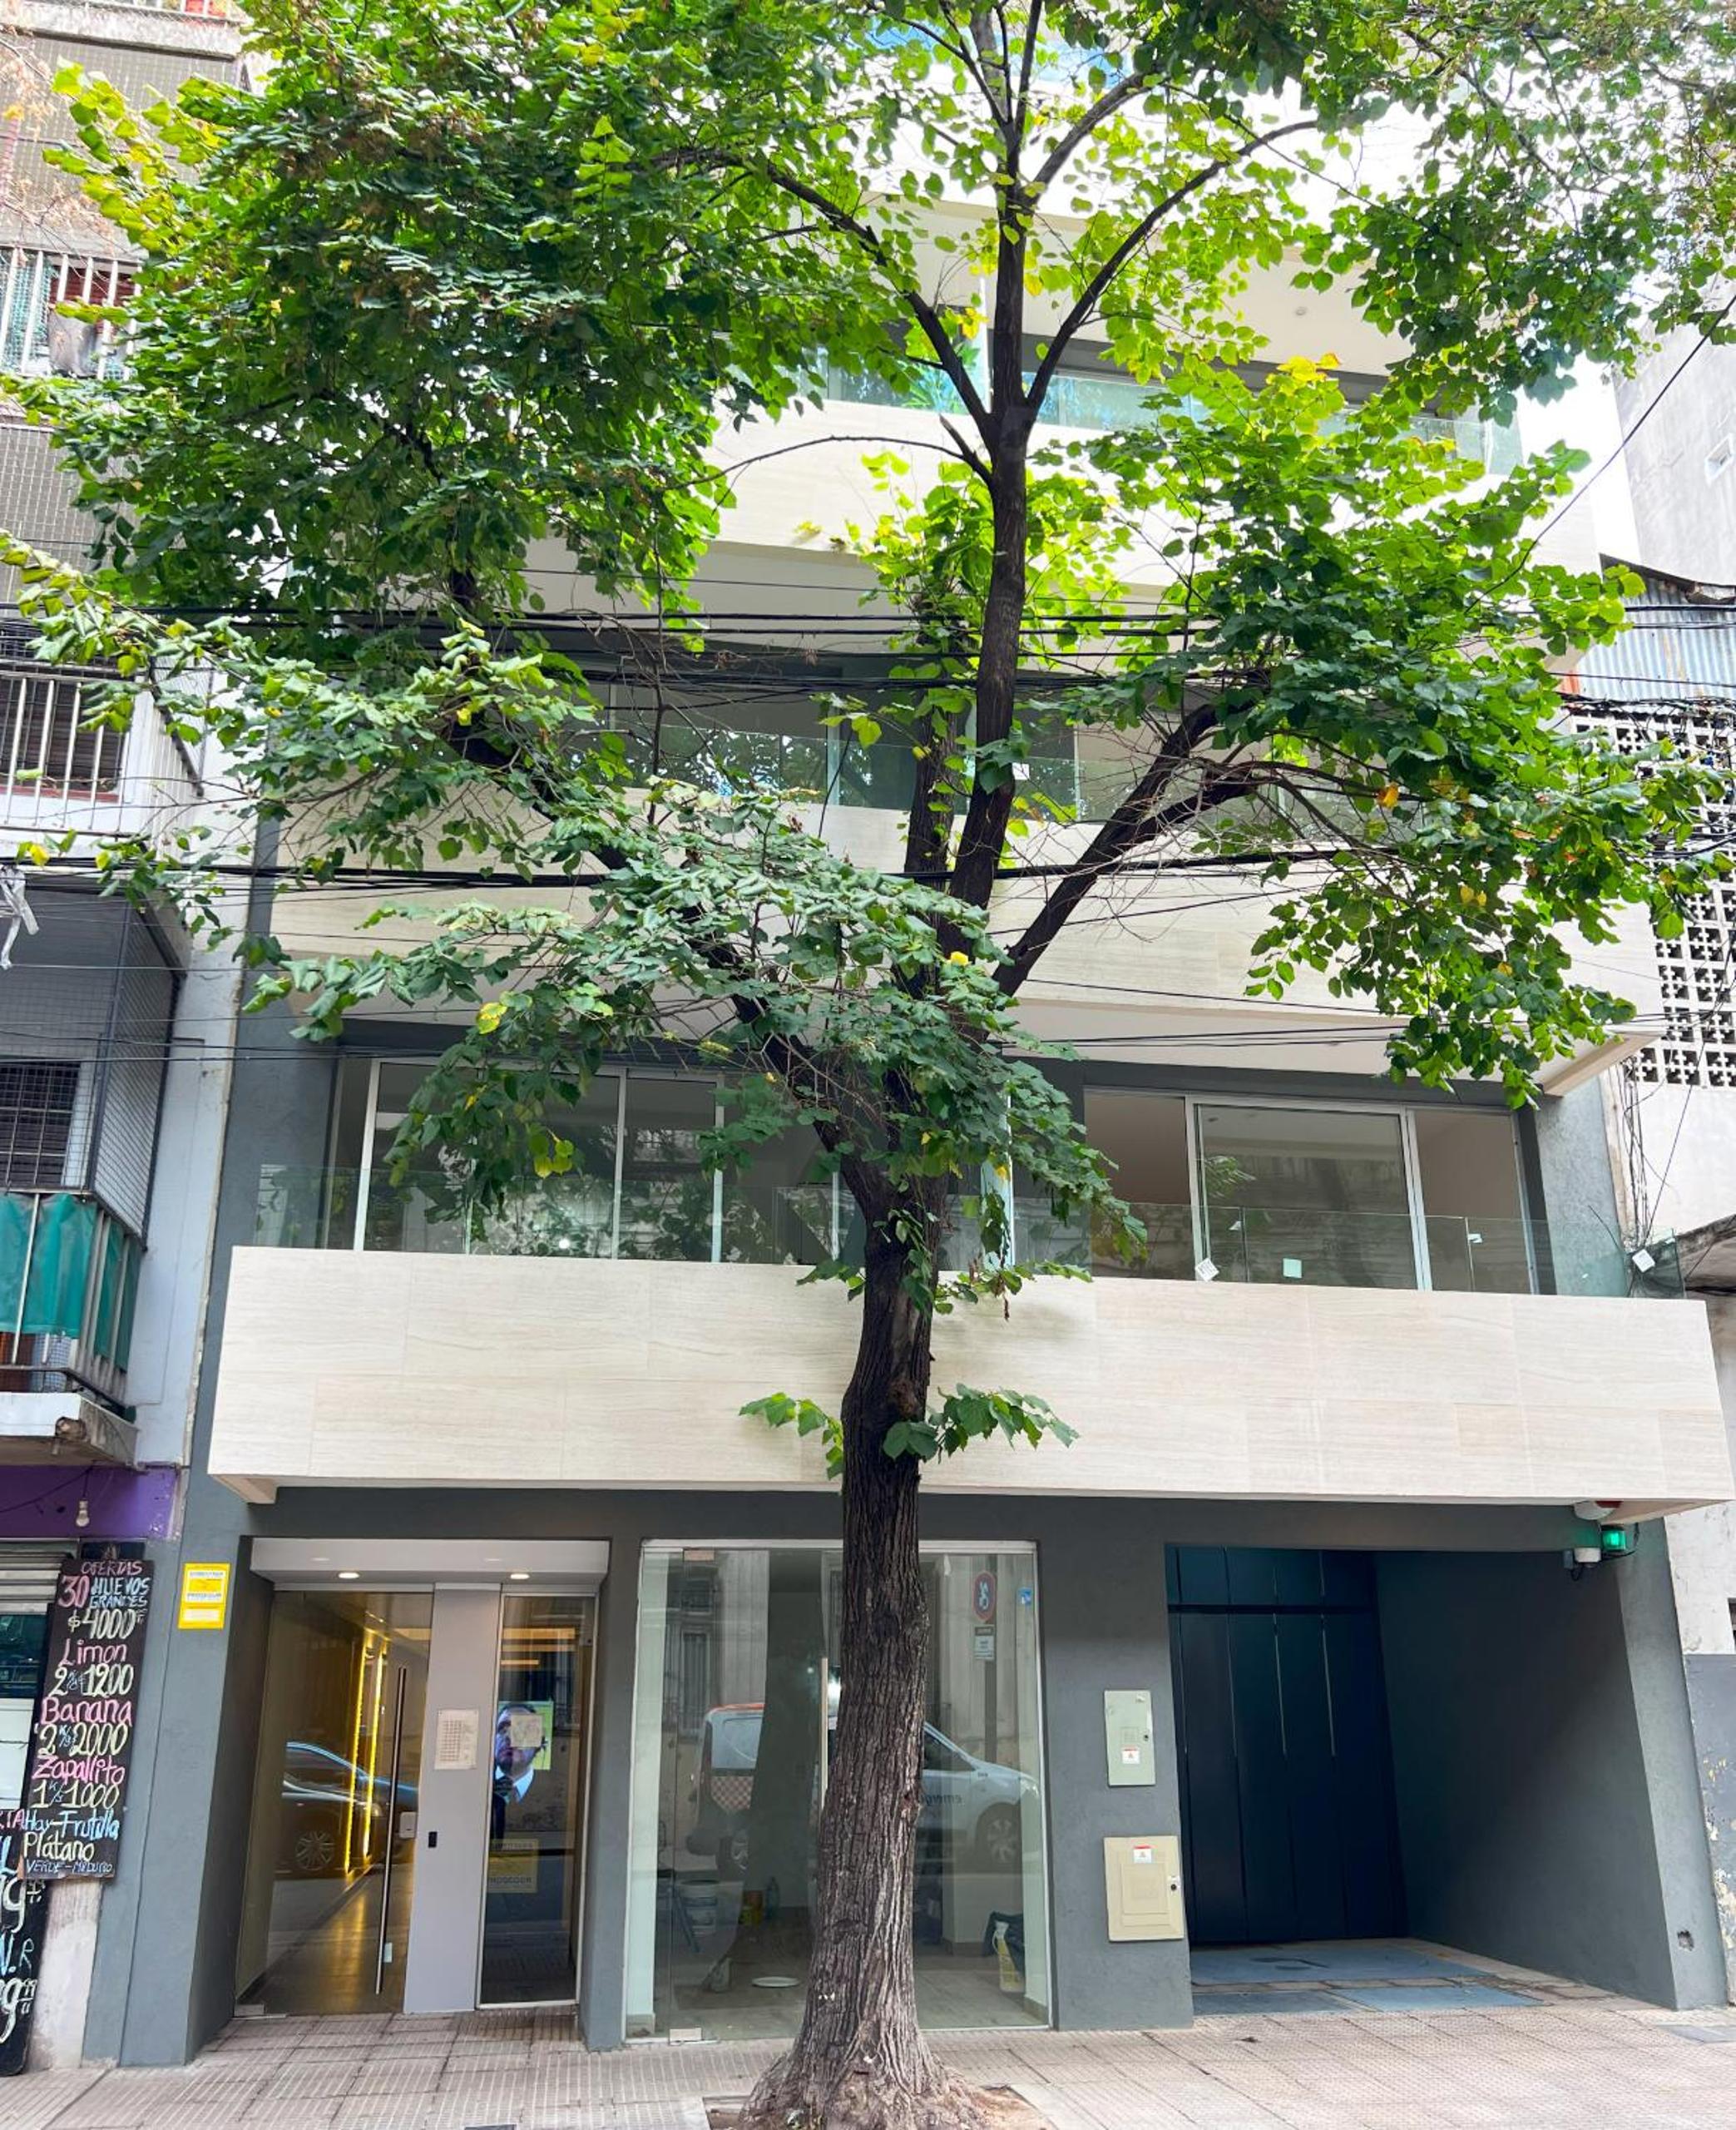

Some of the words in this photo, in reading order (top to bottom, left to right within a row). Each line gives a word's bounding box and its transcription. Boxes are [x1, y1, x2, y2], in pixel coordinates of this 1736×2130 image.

[81, 1561, 143, 1575] OFERTAS
[58, 1575, 91, 1608] 30
[91, 1577, 151, 1596] HUEVOS
[57, 1638, 127, 1667] Limon
[41, 1697, 132, 1727] Banana
[32, 1755, 126, 1786] Zapallito
[23, 1830, 95, 1862] Plátano
